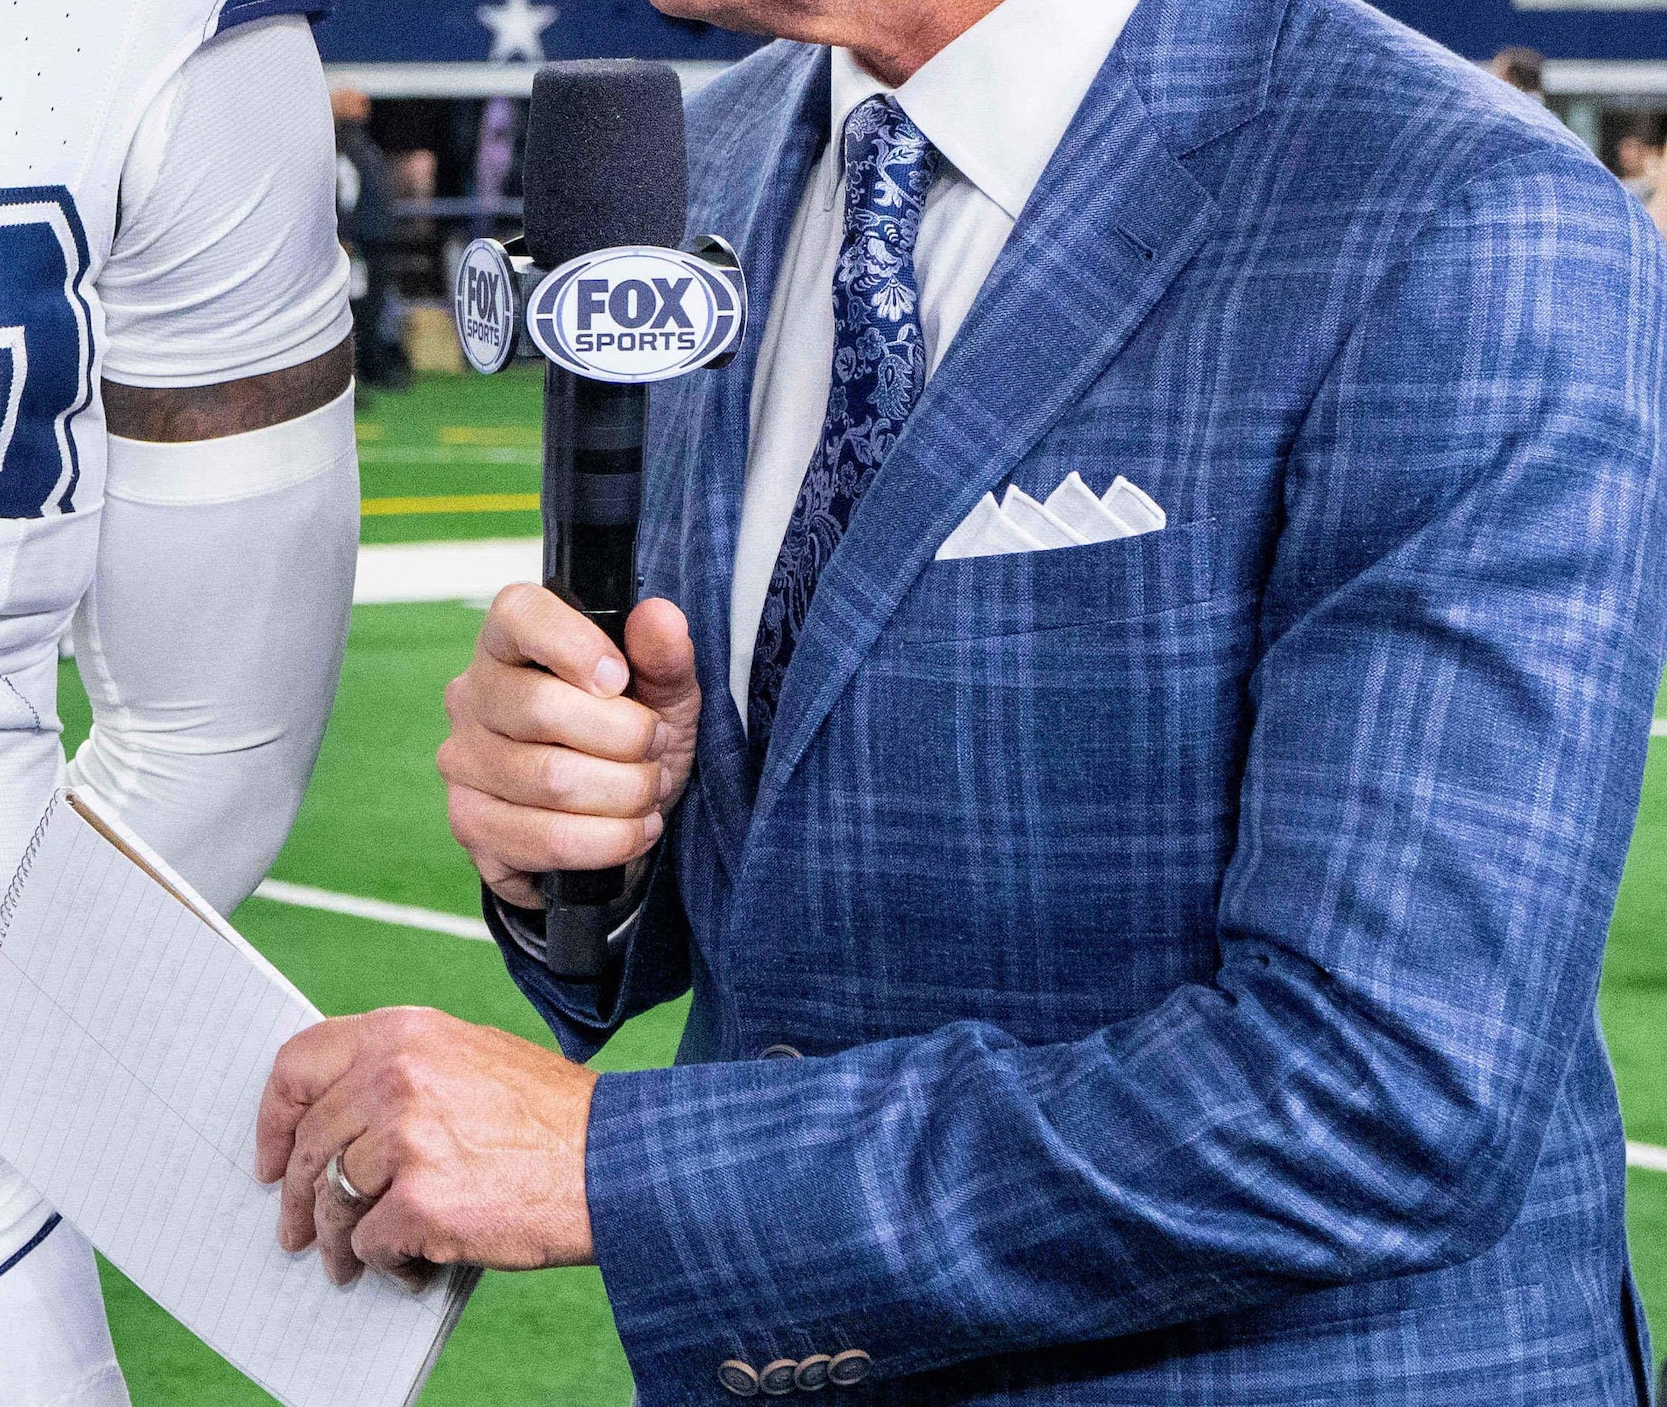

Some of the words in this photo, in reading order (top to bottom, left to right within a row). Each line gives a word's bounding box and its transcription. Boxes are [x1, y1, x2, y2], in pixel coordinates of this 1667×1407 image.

[467, 264, 500, 326] FOX
[576, 276, 694, 331] FOX
[467, 318, 500, 348] SPORTS
[575, 331, 696, 353] SPORTS
